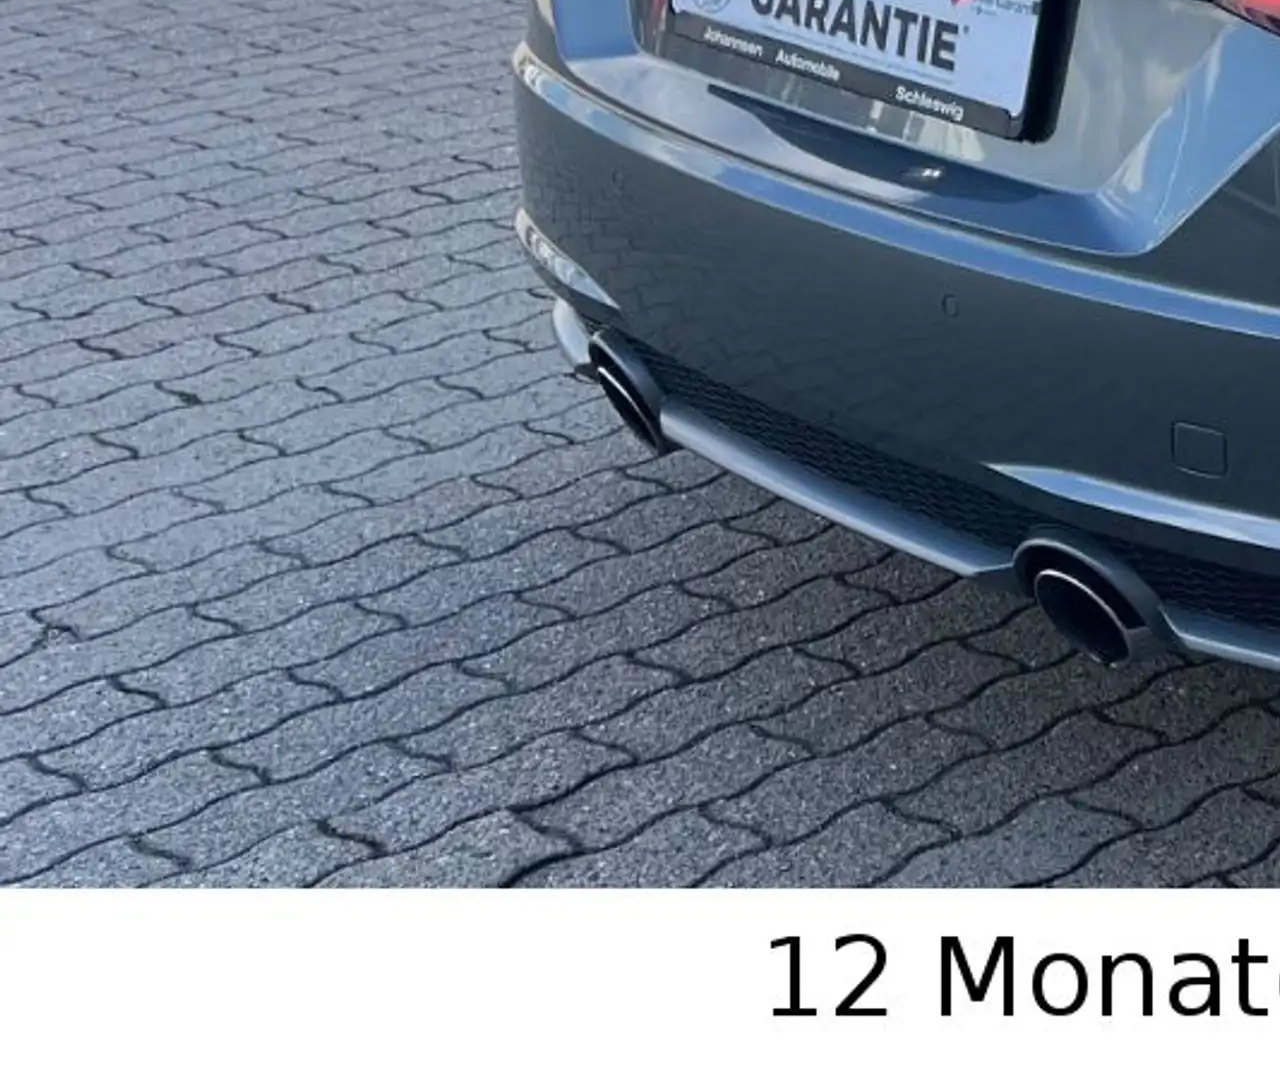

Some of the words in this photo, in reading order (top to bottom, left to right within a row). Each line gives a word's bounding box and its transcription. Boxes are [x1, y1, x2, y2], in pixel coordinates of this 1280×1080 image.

[703, 25, 764, 58] Johannsen
[775, 48, 840, 82] Automobile
[894, 84, 965, 122] Schleswig
